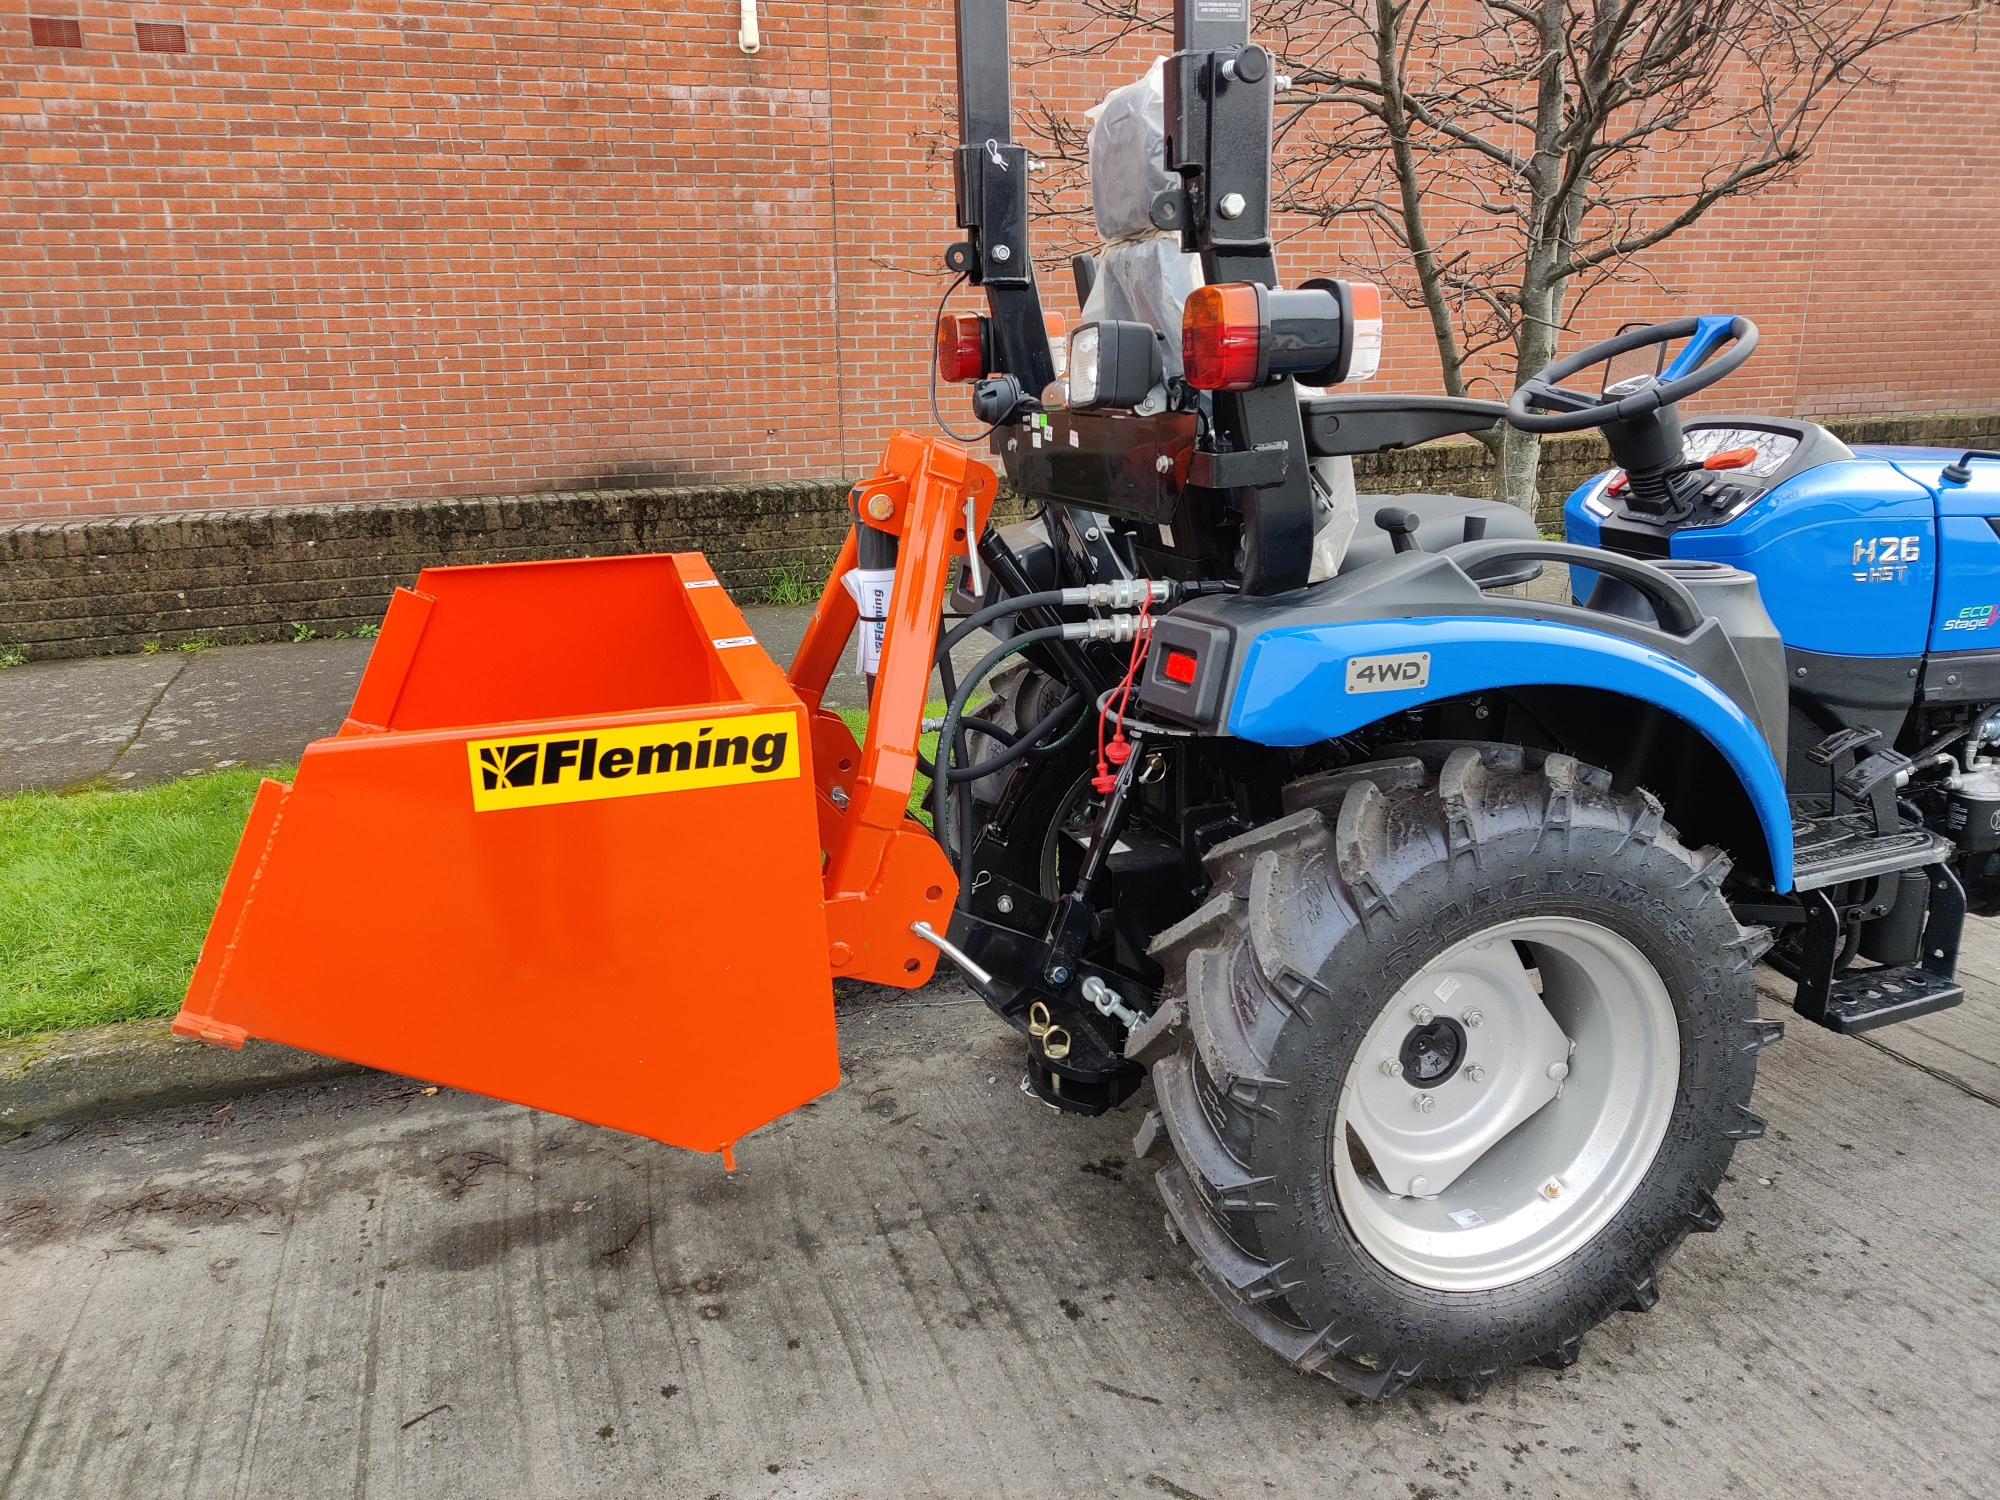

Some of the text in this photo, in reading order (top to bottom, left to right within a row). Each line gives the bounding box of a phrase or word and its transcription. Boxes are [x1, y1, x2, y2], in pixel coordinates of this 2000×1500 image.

[1853, 535, 1920, 566] H26
[1959, 605, 1993, 619] ECO
[1356, 661, 1421, 683] 4WD
[541, 726, 788, 785] Fleming
